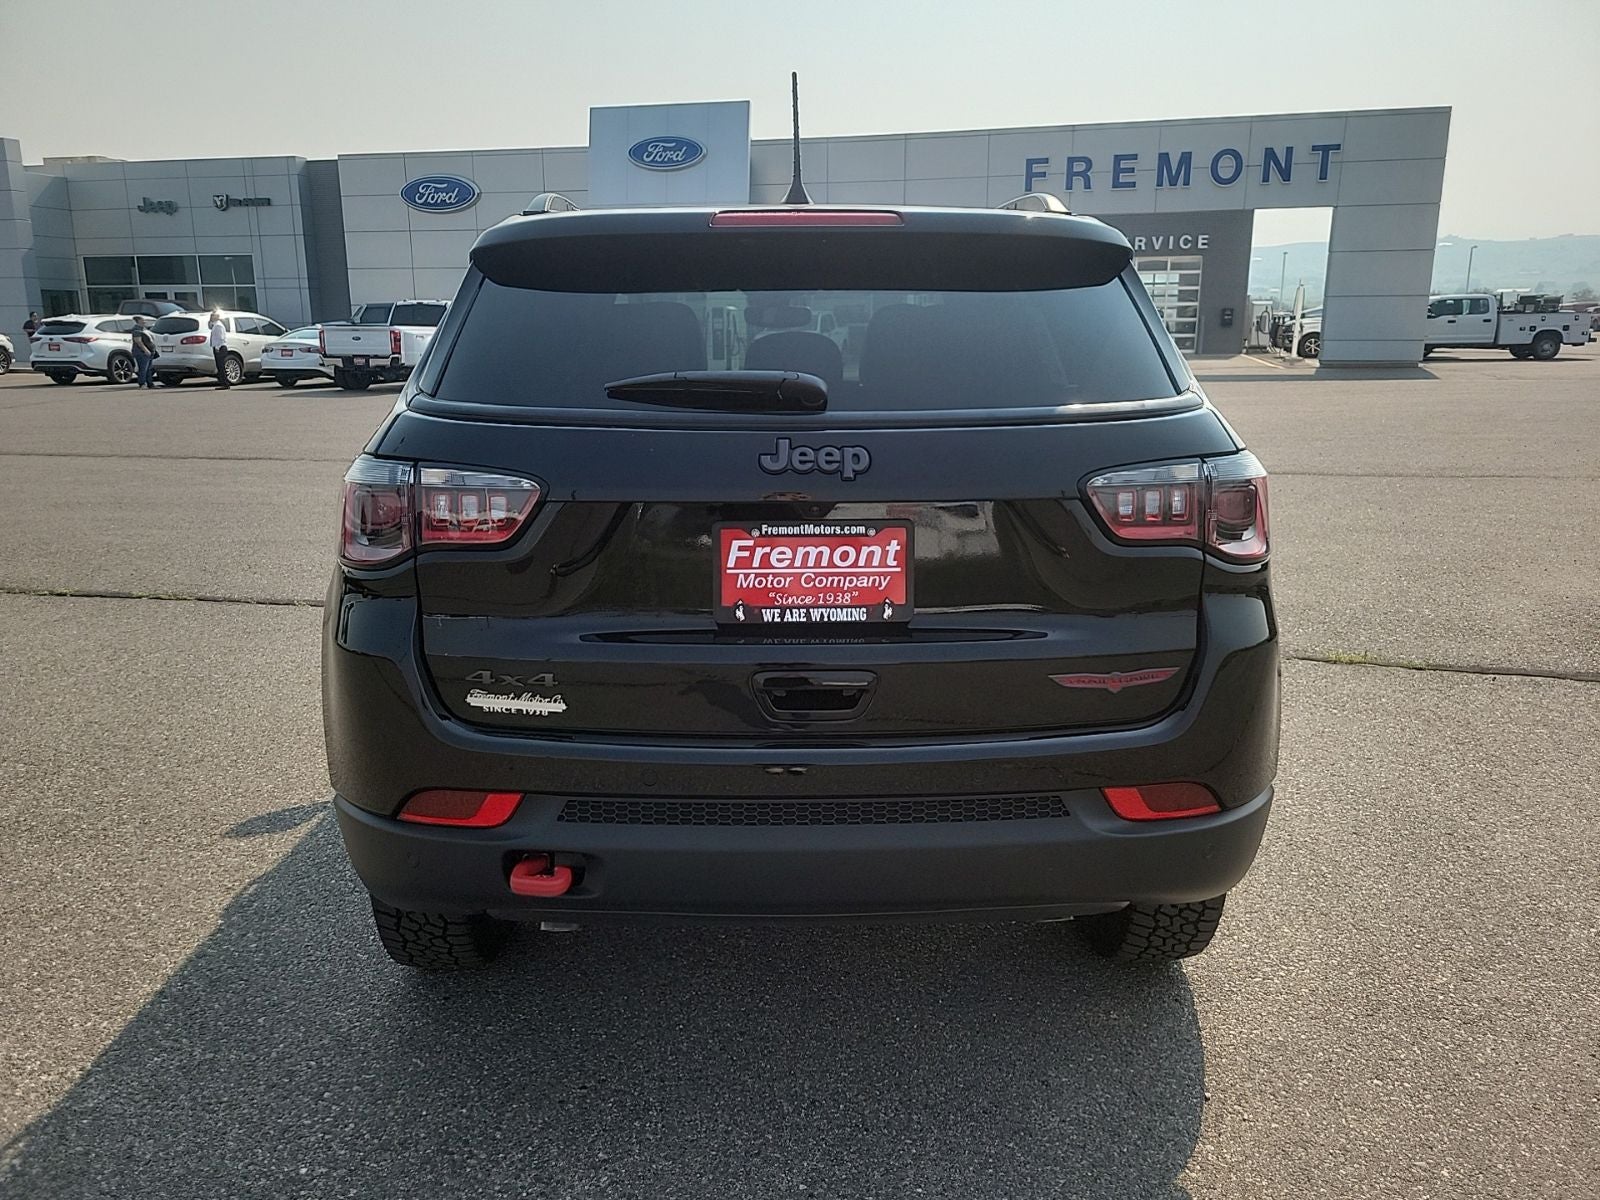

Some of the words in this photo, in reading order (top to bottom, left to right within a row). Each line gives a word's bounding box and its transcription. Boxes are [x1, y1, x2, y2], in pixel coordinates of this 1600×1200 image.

[643, 142, 687, 162] Ford
[1024, 143, 1342, 192] FREMONT
[415, 182, 460, 204] Ford
[1134, 234, 1210, 250] RVICE
[758, 437, 872, 481] Jeep
[761, 524, 866, 536] FremontMotors.com
[727, 540, 901, 568] Fremont
[737, 573, 794, 589] Motor
[800, 573, 891, 591] Company
[762, 608, 781, 622] WE
[784, 608, 807, 622] ARE
[809, 607, 867, 622] WYOMING
[465, 670, 558, 687] 4x4
